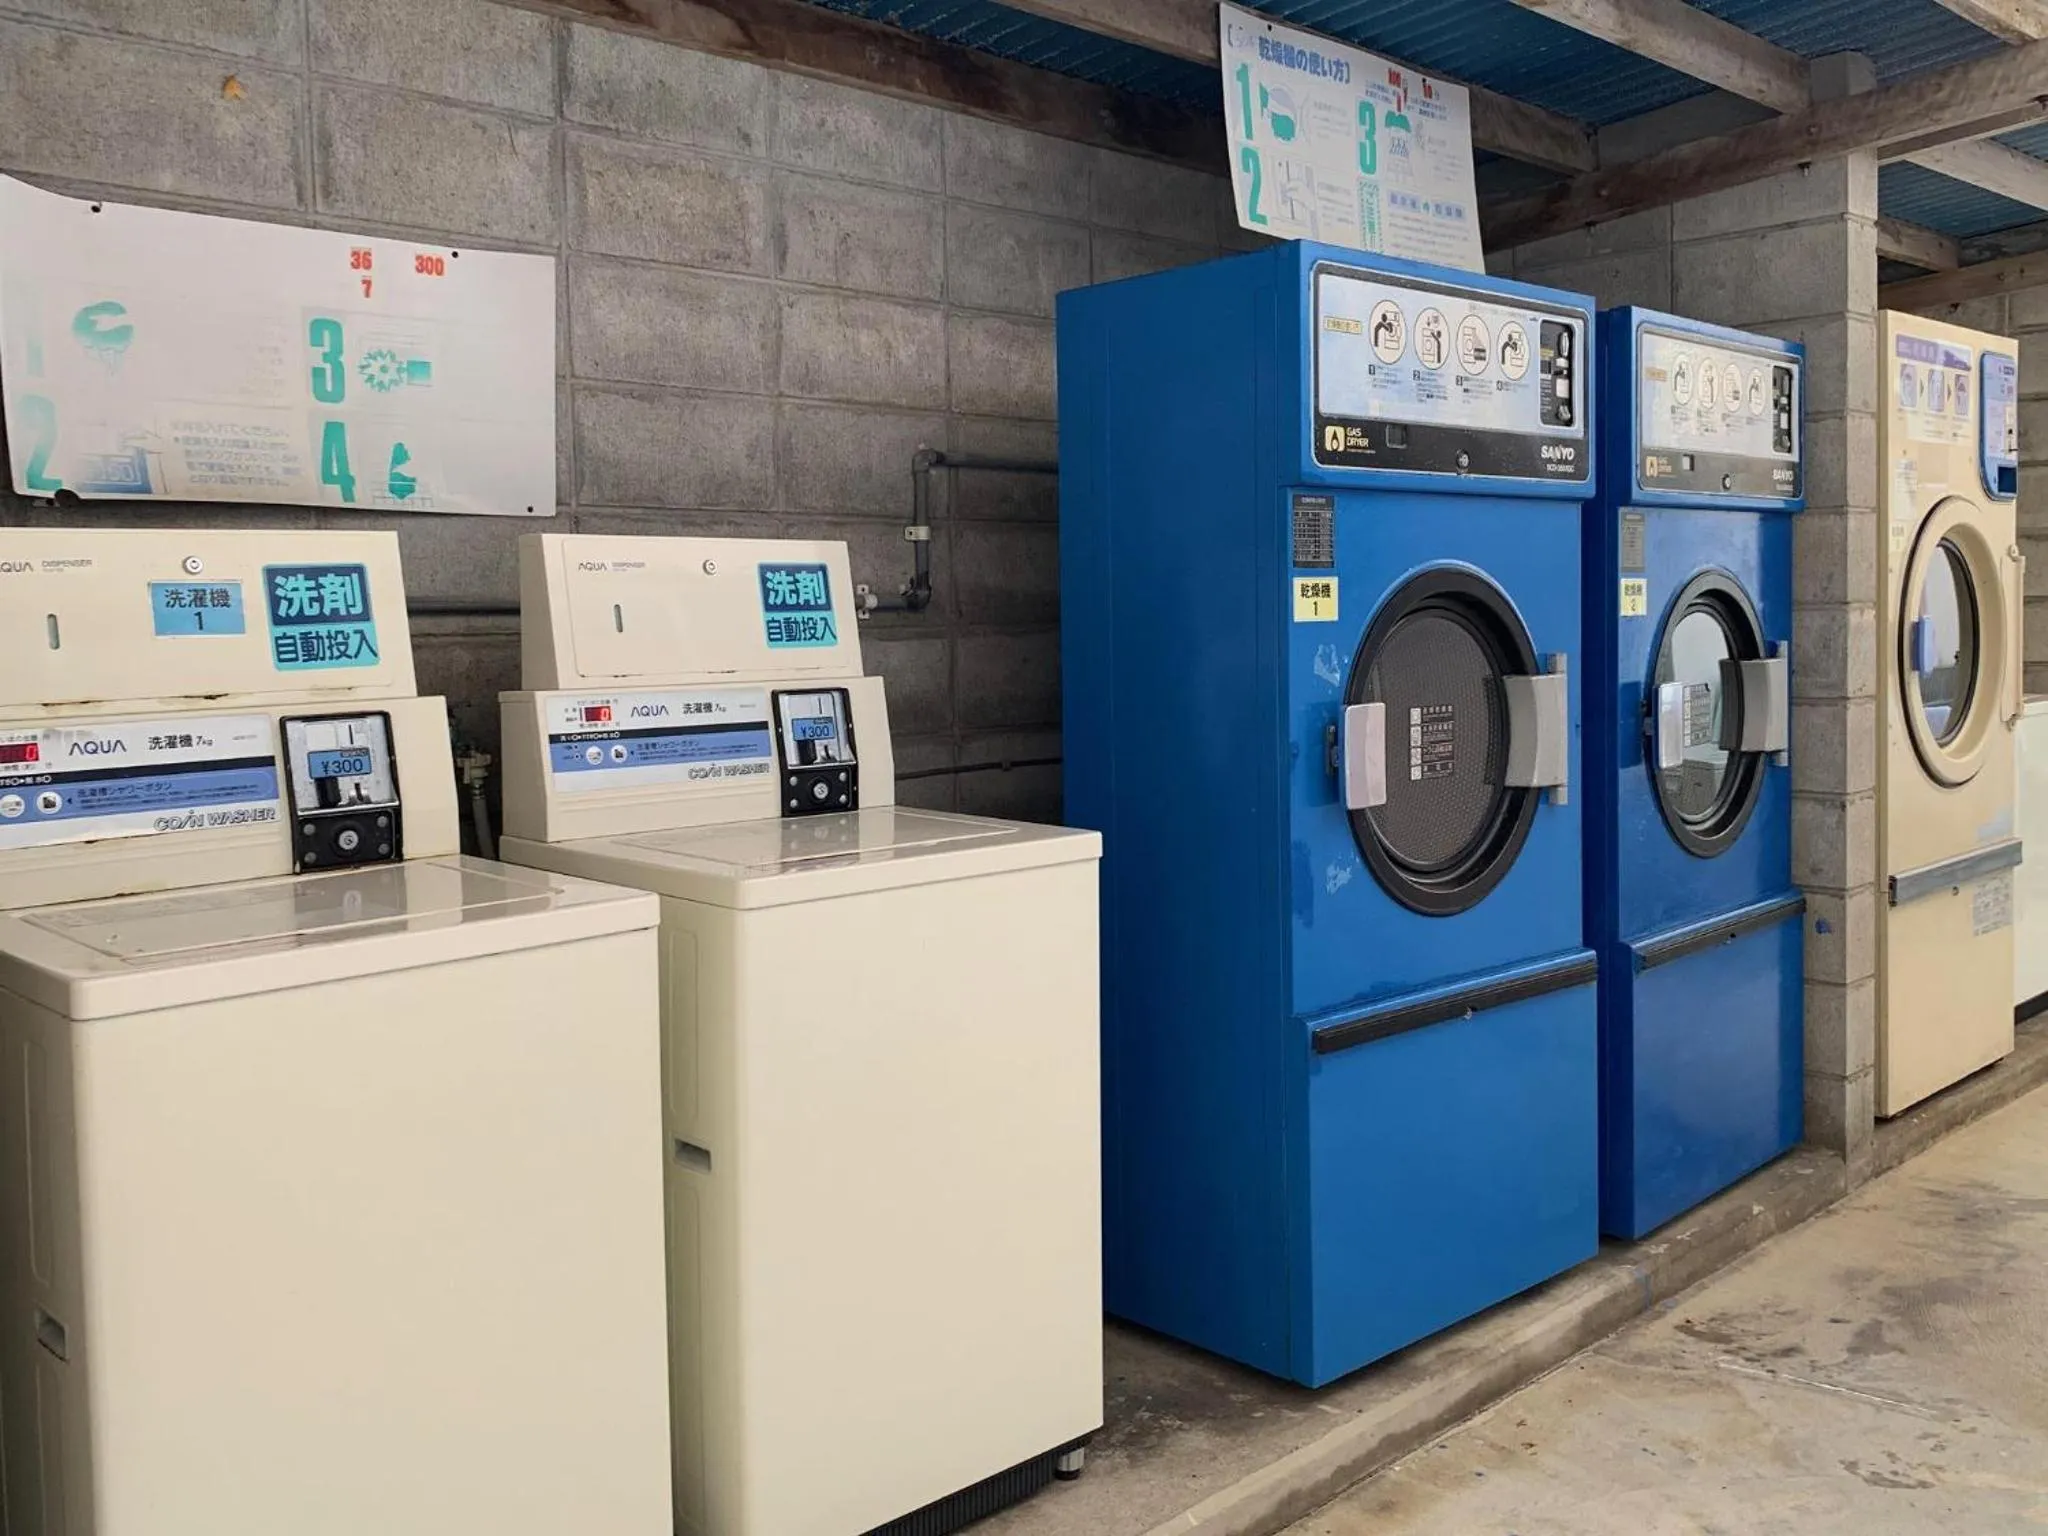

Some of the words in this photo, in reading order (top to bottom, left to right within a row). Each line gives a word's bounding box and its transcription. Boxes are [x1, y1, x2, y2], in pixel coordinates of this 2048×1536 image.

[1236, 62, 1254, 140] 1
[1358, 100, 1377, 176] 3
[1241, 147, 1269, 226] 2
[350, 250, 373, 271] 36
[415, 254, 445, 277] 300
[361, 279, 373, 299] 7
[309, 318, 346, 404] 3
[15, 394, 63, 491] 2
[1541, 445, 1575, 461] SANYO
[320, 420, 357, 503] 4
[578, 561, 608, 572] AQUA
[164, 588, 232, 610] 洗濯機
[274, 572, 363, 619] 洗剤
[766, 570, 827, 606] 洗剤
[1300, 582, 1332, 599] 乾燥機
[1313, 600, 1319, 616] 1
[193, 611, 205, 632] 1
[767, 616, 837, 643] 自動投入
[275, 629, 378, 664] 自動投入
[600, 708, 610, 721] 0
[630, 704, 670, 718] AQUA
[681, 702, 713, 715] 洗濯機
[25, 745, 37, 761] 0
[69, 734, 128, 757] AQUA
[148, 733, 194, 751] 洗濯機
[321, 759, 364, 775] ¥300
